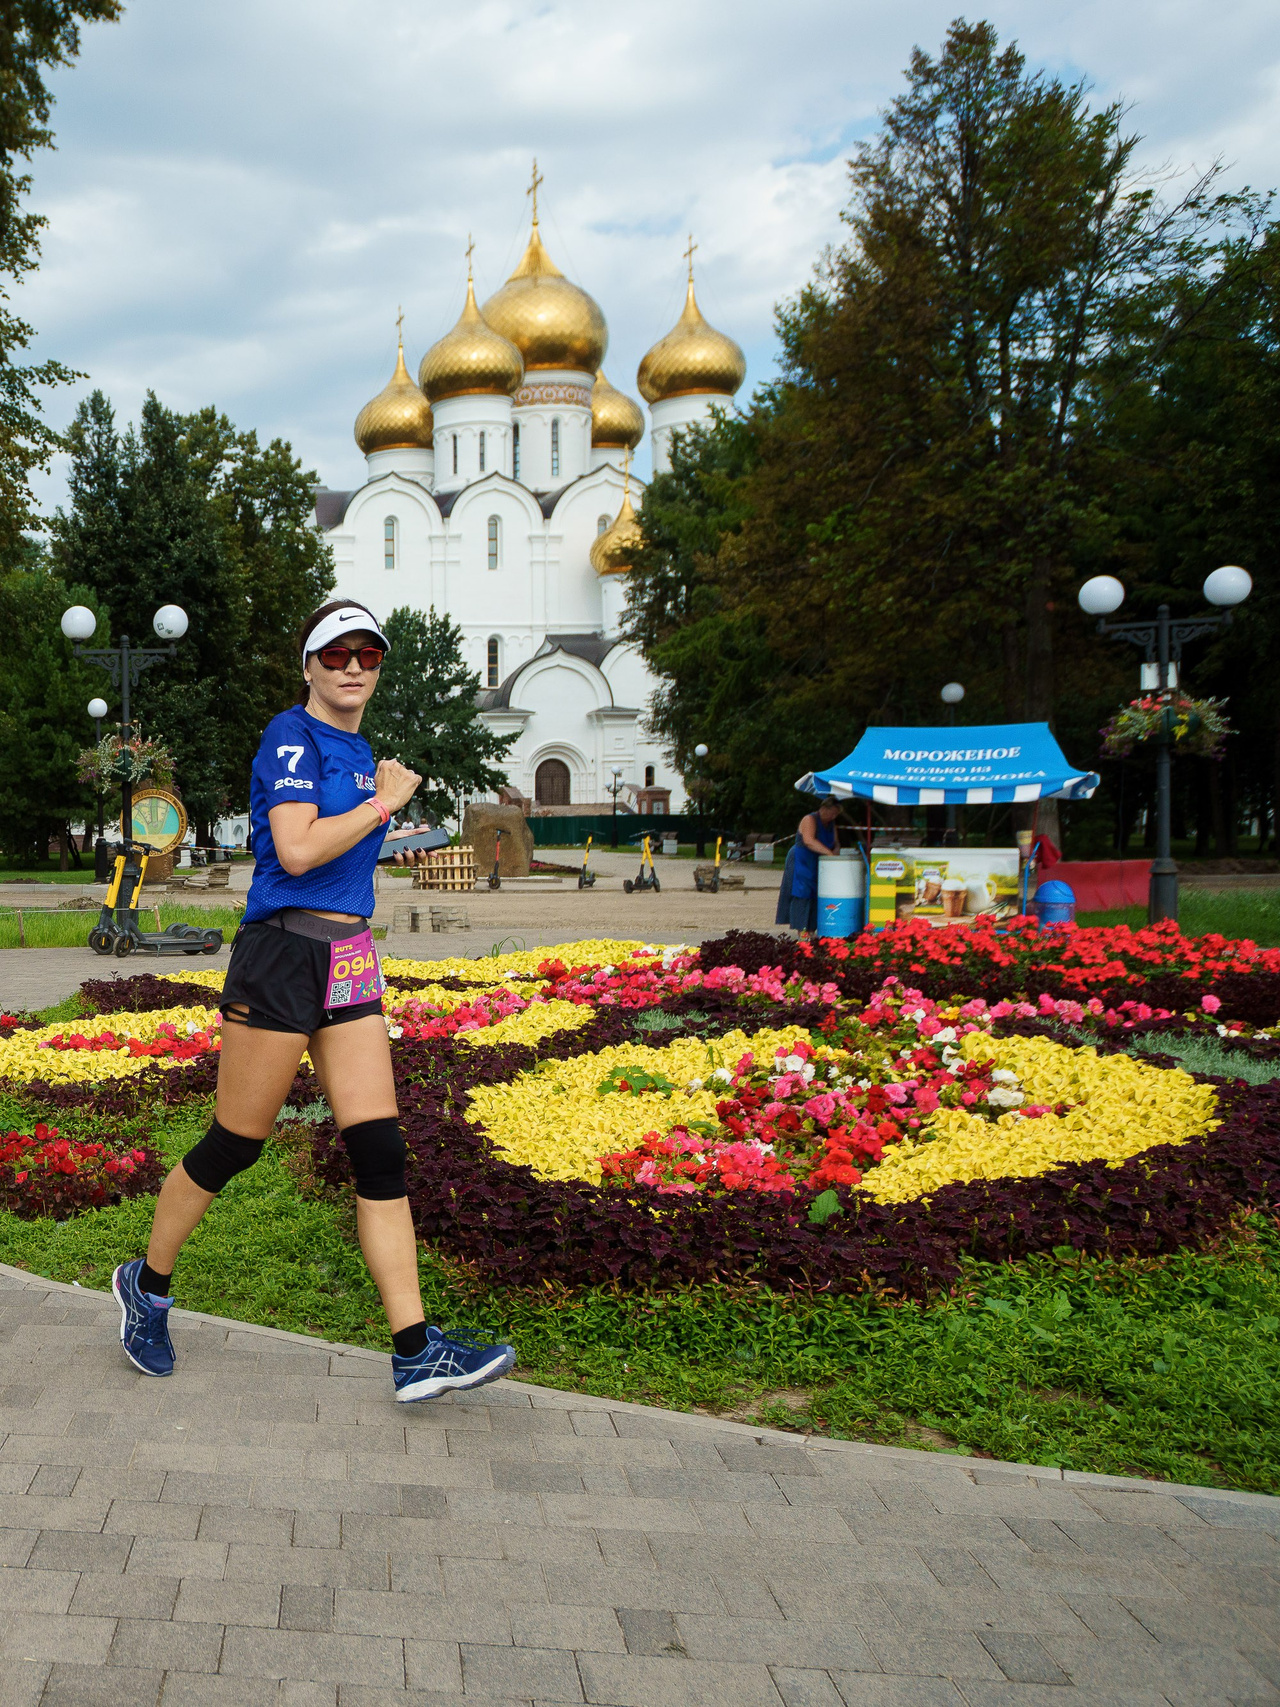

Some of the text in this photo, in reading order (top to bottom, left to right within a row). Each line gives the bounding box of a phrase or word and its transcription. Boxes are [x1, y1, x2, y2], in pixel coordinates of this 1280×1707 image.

[276, 745, 305, 773] 7
[882, 746, 1022, 762] МОРОЖЕНОЕ
[848, 770, 1047, 783] СВЕЖЕГО МОЛОКА
[905, 765, 992, 775] ТОЛЬКО ИЗ
[274, 776, 314, 791] 2023
[334, 944, 354, 954] RUTS
[333, 951, 375, 979] 094
